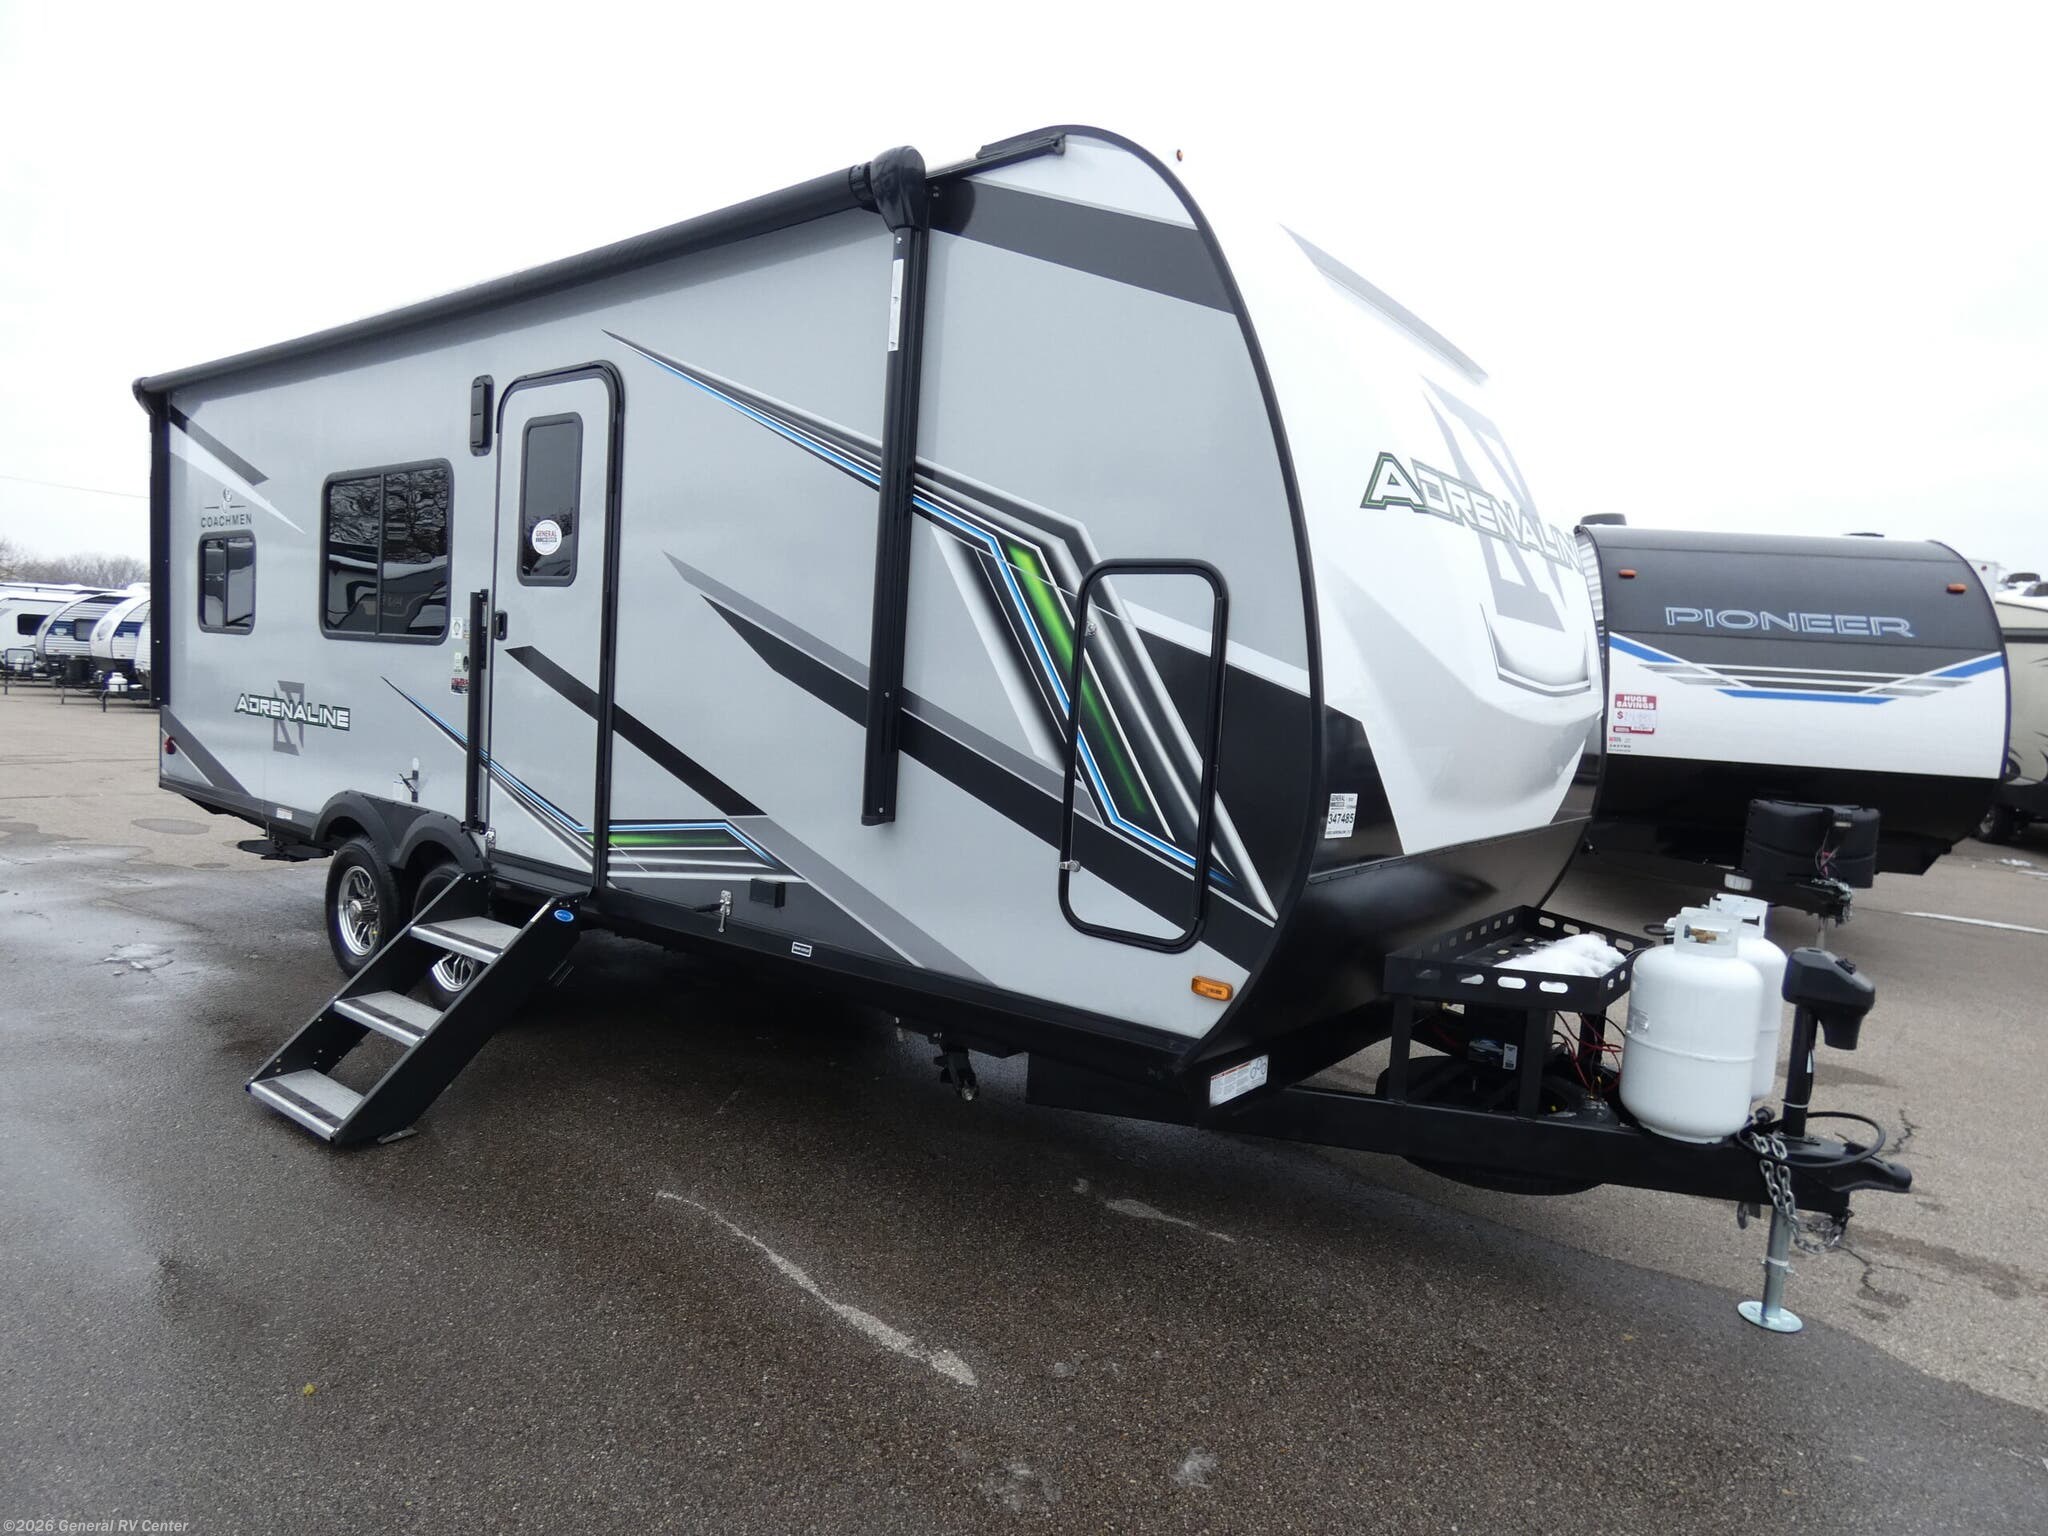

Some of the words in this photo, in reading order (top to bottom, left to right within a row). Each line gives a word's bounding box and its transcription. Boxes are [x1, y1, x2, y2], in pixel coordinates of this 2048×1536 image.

[201, 513, 252, 528] COACHMEN
[1359, 451, 1587, 575] ADRENALIN
[1665, 606, 1915, 638] PIONEER
[234, 693, 351, 731] ADRENALINE
[1616, 701, 1655, 709] SAVINGS
[1328, 812, 1354, 824] 347485
